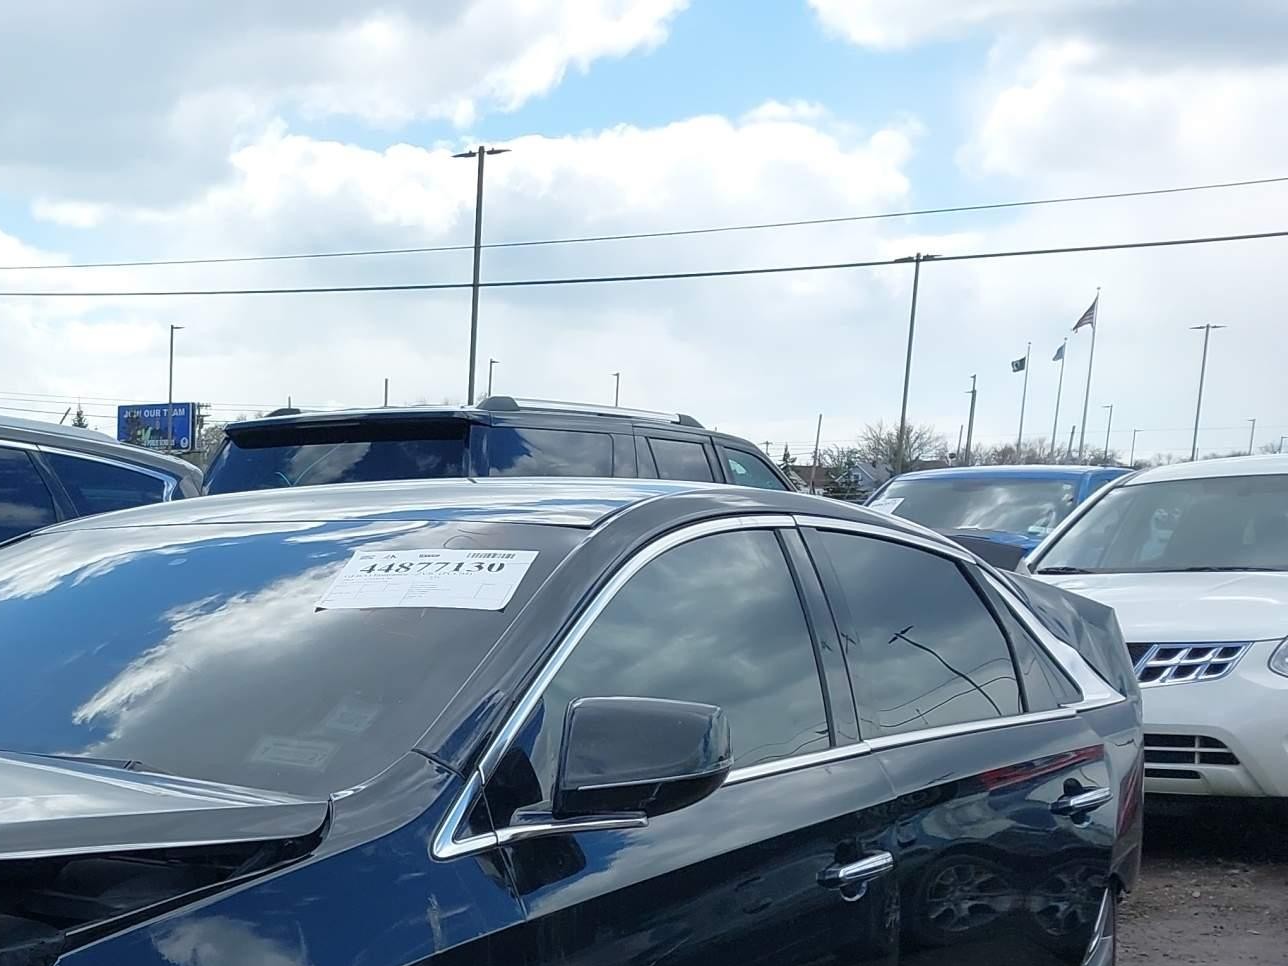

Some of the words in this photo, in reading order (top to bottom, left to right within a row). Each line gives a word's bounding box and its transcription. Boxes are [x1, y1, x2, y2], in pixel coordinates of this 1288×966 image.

[143, 409, 161, 418] OUR
[162, 408, 185, 417] TAM
[359, 561, 505, 574] 44877130
